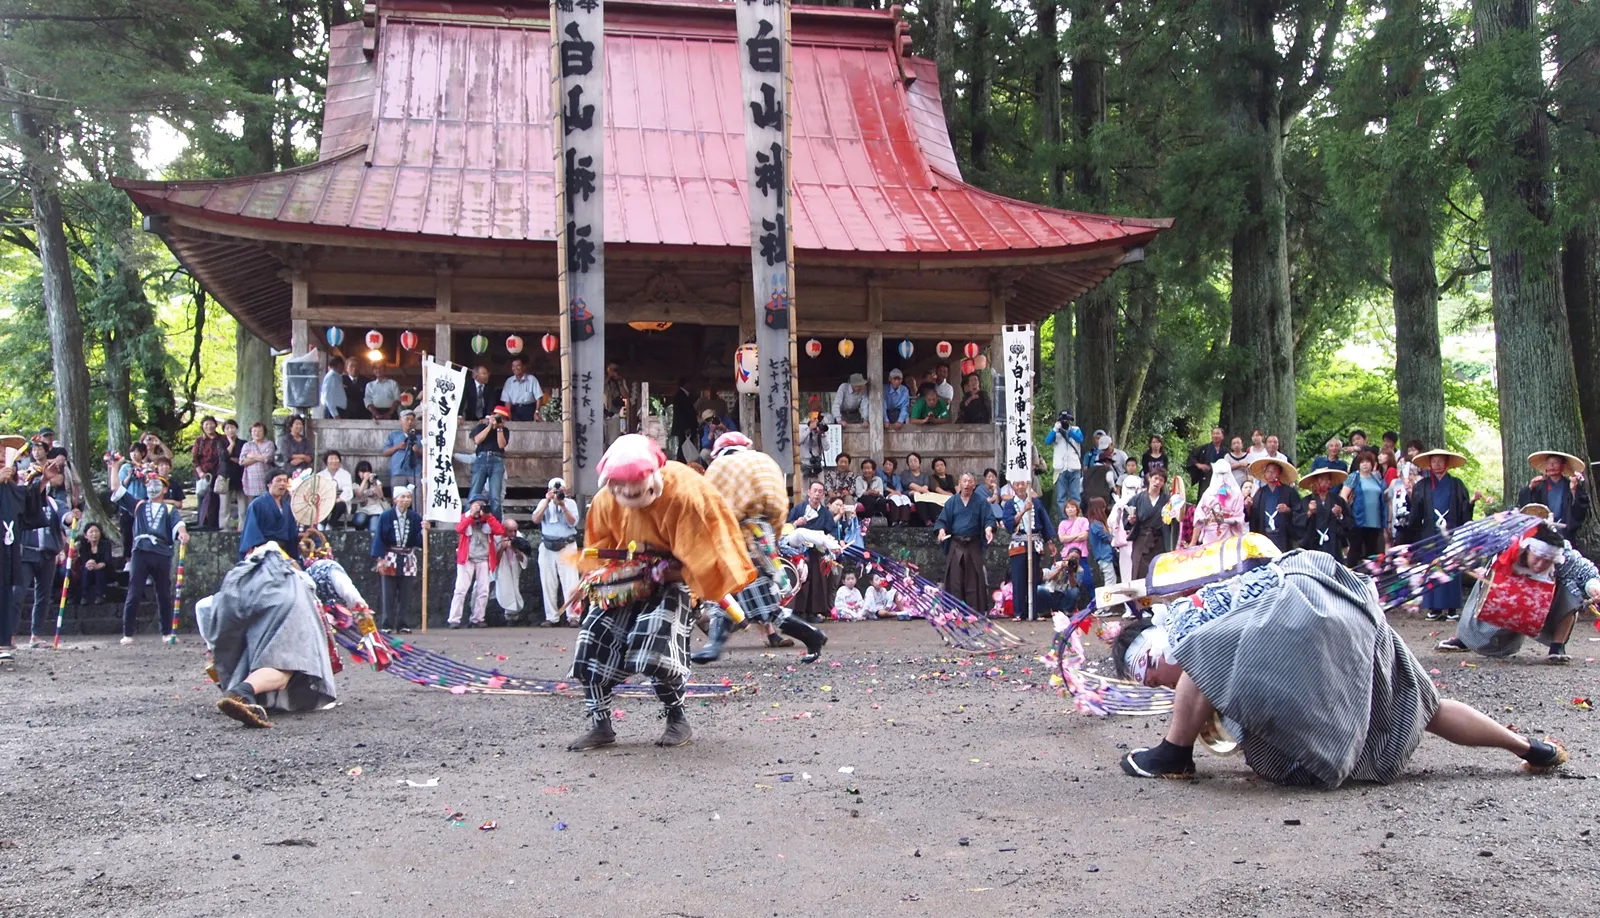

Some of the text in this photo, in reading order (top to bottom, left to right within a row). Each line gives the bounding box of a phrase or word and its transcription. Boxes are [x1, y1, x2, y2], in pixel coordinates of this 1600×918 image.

[745, 18, 787, 267] 白山神社
[775, 407, 790, 452] 男子
